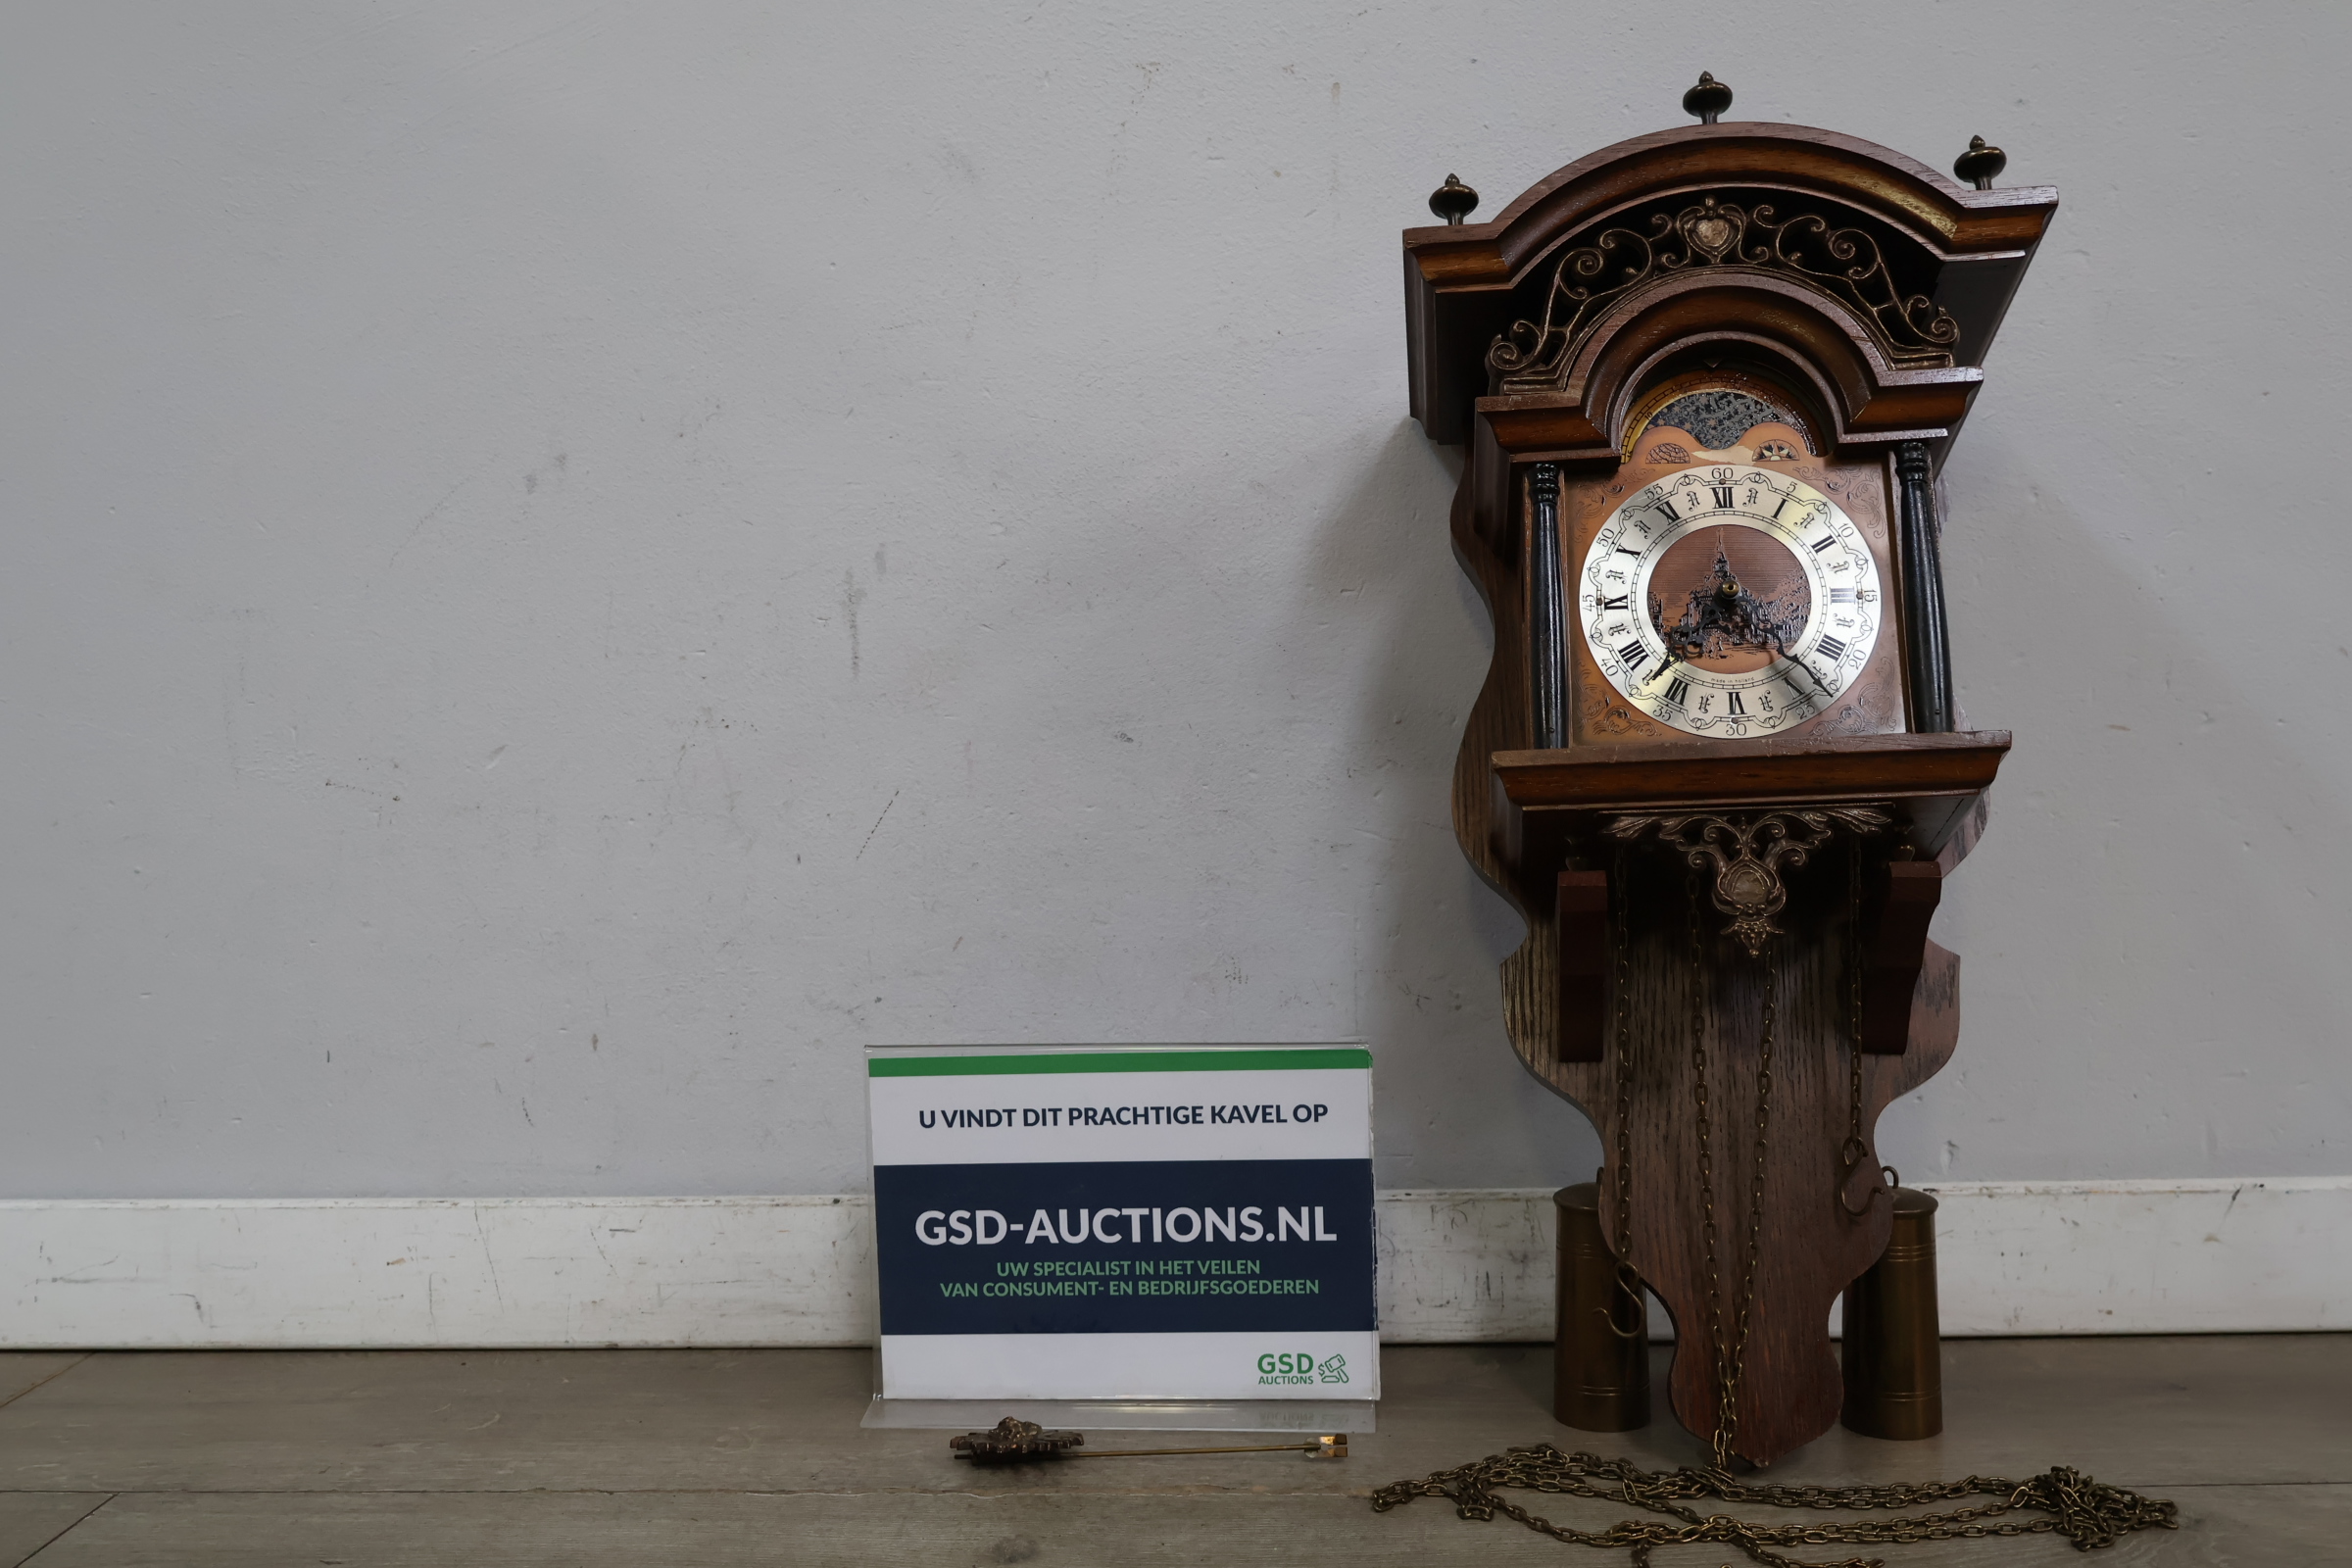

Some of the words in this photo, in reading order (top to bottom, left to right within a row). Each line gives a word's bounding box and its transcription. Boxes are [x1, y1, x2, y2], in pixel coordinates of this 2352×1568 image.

[1712, 467, 1734, 479] 60
[1644, 483, 1664, 500] 55
[1787, 482, 1797, 493] 5
[1709, 487, 1735, 509] XII
[1654, 500, 1683, 526] XI
[1771, 498, 1789, 520] I
[1596, 528, 1615, 547] 50
[1838, 523, 1855, 538] 10
[1615, 544, 1642, 561] X
[1810, 533, 1838, 556] II
[1583, 594, 1595, 612] 45
[1603, 593, 1629, 612] IX
[1830, 586, 1855, 605] III
[1864, 589, 1878, 603] 15
[1617, 638, 1650, 672] VIII
[1815, 633, 1847, 662] IIII
[1601, 659, 1619, 677] 40
[1848, 649, 1867, 669] 20
[1663, 676, 1691, 706] VII
[1782, 676, 1805, 701] V
[1653, 705, 1674, 721] 35
[1727, 692, 1747, 715] VI
[1795, 703, 1816, 720] 25
[1725, 724, 1747, 736] 30
[919, 1110, 935, 1128] U
[941, 1108, 1016, 1128] VINDT
[1023, 1108, 1062, 1126] DIT
[1068, 1105, 1203, 1126] PRACHTIGE
[1211, 1104, 1288, 1124] KAVEL
[1293, 1104, 1328, 1123] OP
[915, 1206, 1337, 1246] GSD-AUCTIONS.NL
[998, 1262, 1029, 1276] UW
[1034, 1261, 1131, 1276] SPECIALIST
[1136, 1261, 1153, 1275] IN
[1159, 1260, 1194, 1275] HET
[1198, 1260, 1259, 1274] VEILEN
[940, 1283, 977, 1297] VAN
[983, 1282, 1103, 1297] CONSUMENT-
[1109, 1281, 1132, 1296] EN
[1139, 1280, 1318, 1295] BEDRIJFSGOEDEREN
[1257, 1353, 1314, 1374] GSD
[1258, 1376, 1314, 1385] AUCTIONS
